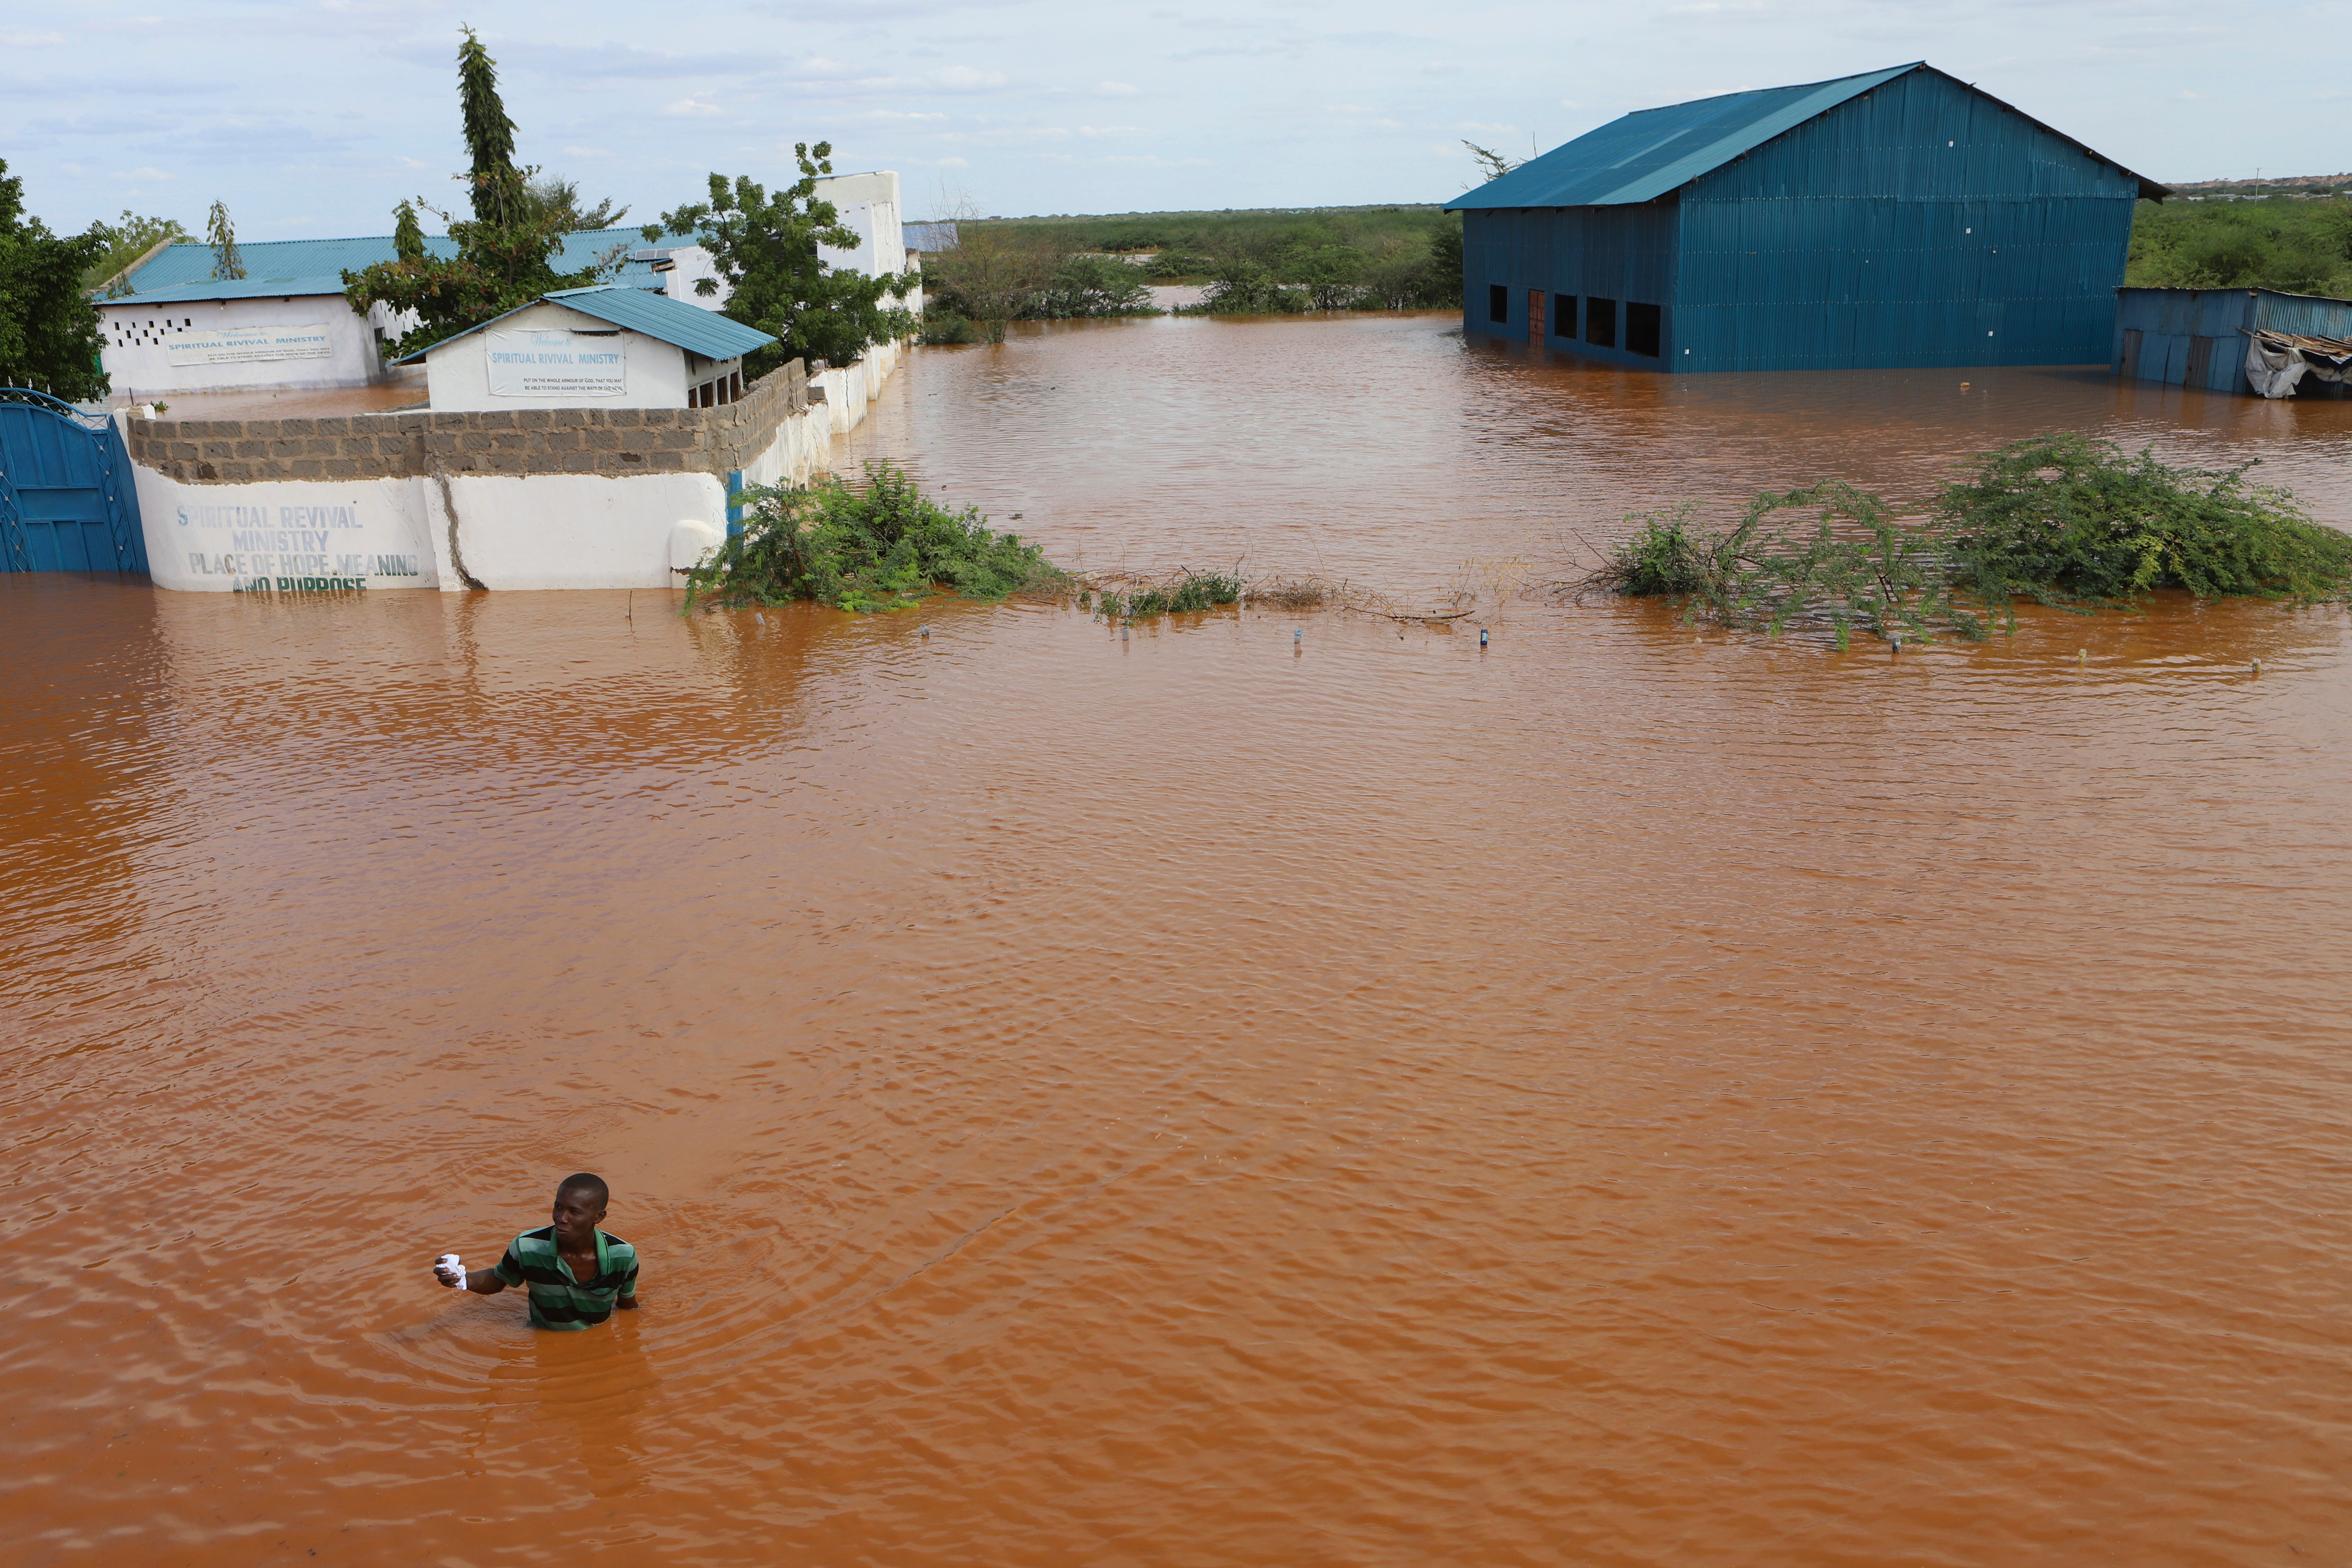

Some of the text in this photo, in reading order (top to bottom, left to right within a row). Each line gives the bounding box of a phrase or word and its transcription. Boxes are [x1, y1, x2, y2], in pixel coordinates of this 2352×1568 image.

[169, 341, 224, 350] SPIRITUAL
[276, 335, 325, 344] MINISTRY
[531, 332, 564, 346] Welcome
[492, 352, 619, 364] SPIRITUAL RIVIVAL MINISTRY
[178, 505, 363, 528] SPIRITUAL REVIVAL
[232, 530, 329, 552] MINISTRY
[188, 553, 248, 576] PLACE
[251, 554, 275, 574] OF
[233, 576, 367, 593] AND PURPOSE
